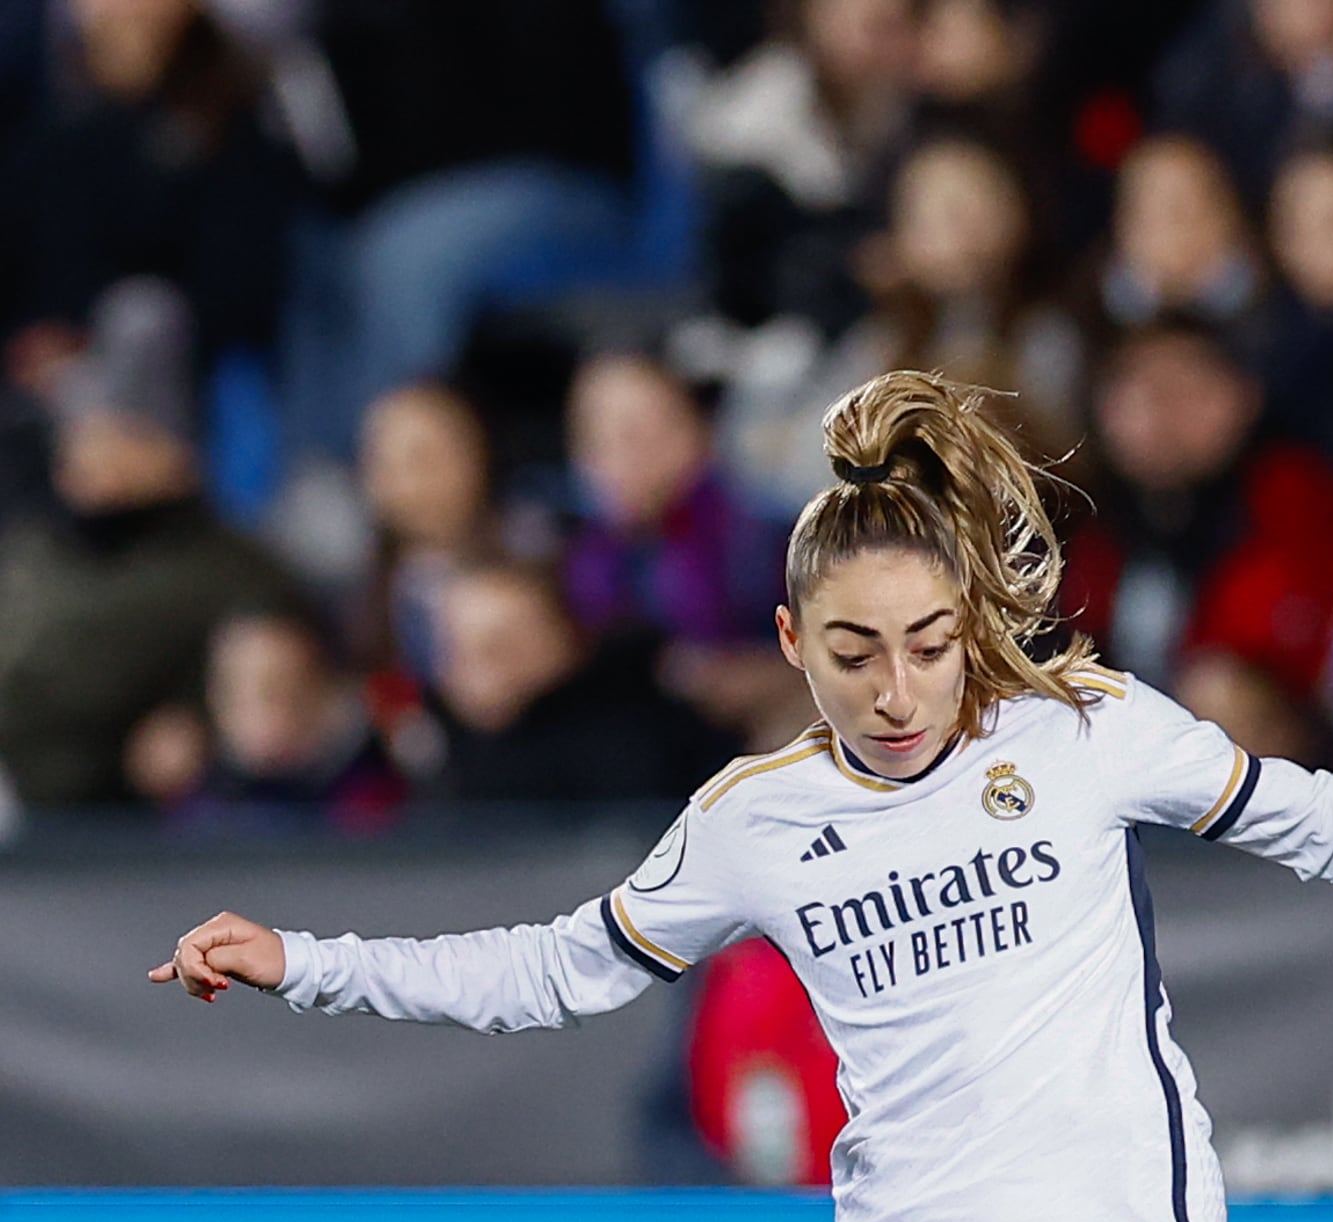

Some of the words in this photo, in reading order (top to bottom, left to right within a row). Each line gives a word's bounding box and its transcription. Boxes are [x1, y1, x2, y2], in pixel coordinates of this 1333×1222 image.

[795, 839, 1061, 958] Emirates
[850, 940, 896, 998] FLY
[911, 901, 1033, 976] BETTER
